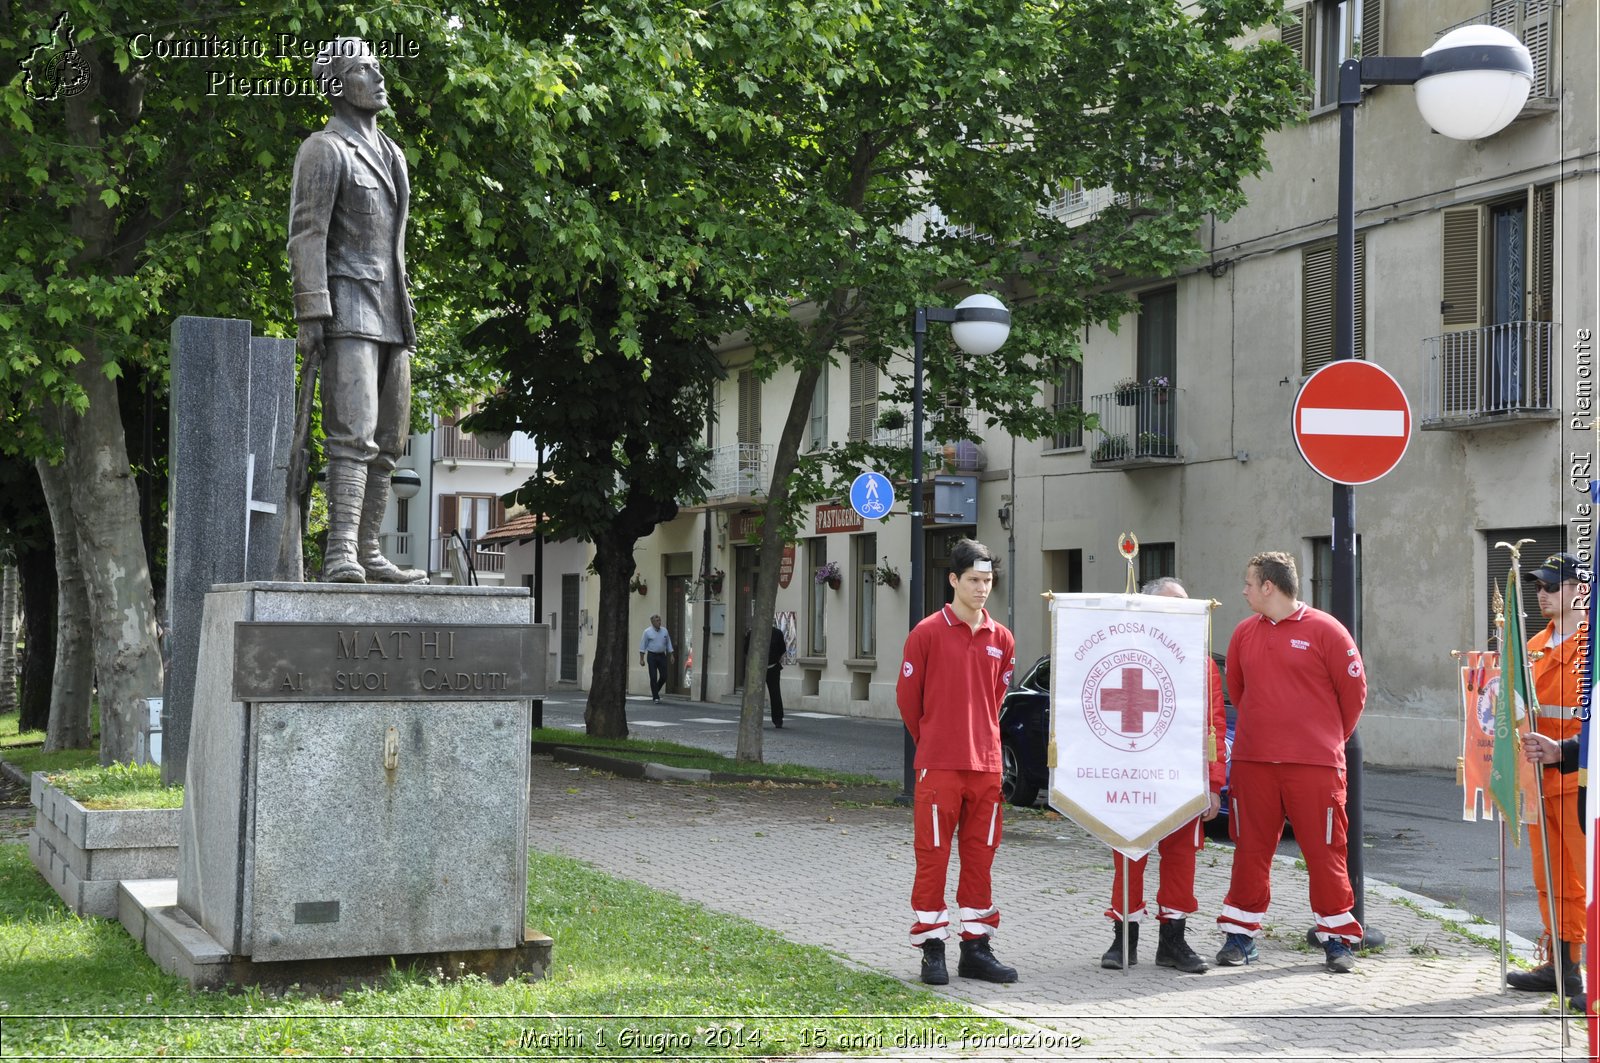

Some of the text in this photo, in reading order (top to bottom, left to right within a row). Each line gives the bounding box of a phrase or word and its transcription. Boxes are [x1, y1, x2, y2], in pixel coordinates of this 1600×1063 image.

[336, 630, 457, 661] MATHI
[1074, 623, 1186, 664] CROCE ROSSA ITALIANA
[279, 672, 304, 691] AI
[335, 671, 389, 691] SUOI
[1084, 652, 1174, 738] CONVENZIONE DI GINEVRA 22 AGOSTO 1864
[1076, 767, 1180, 780] DELEGAZIONE DI
[1105, 791, 1157, 804] MATHI
